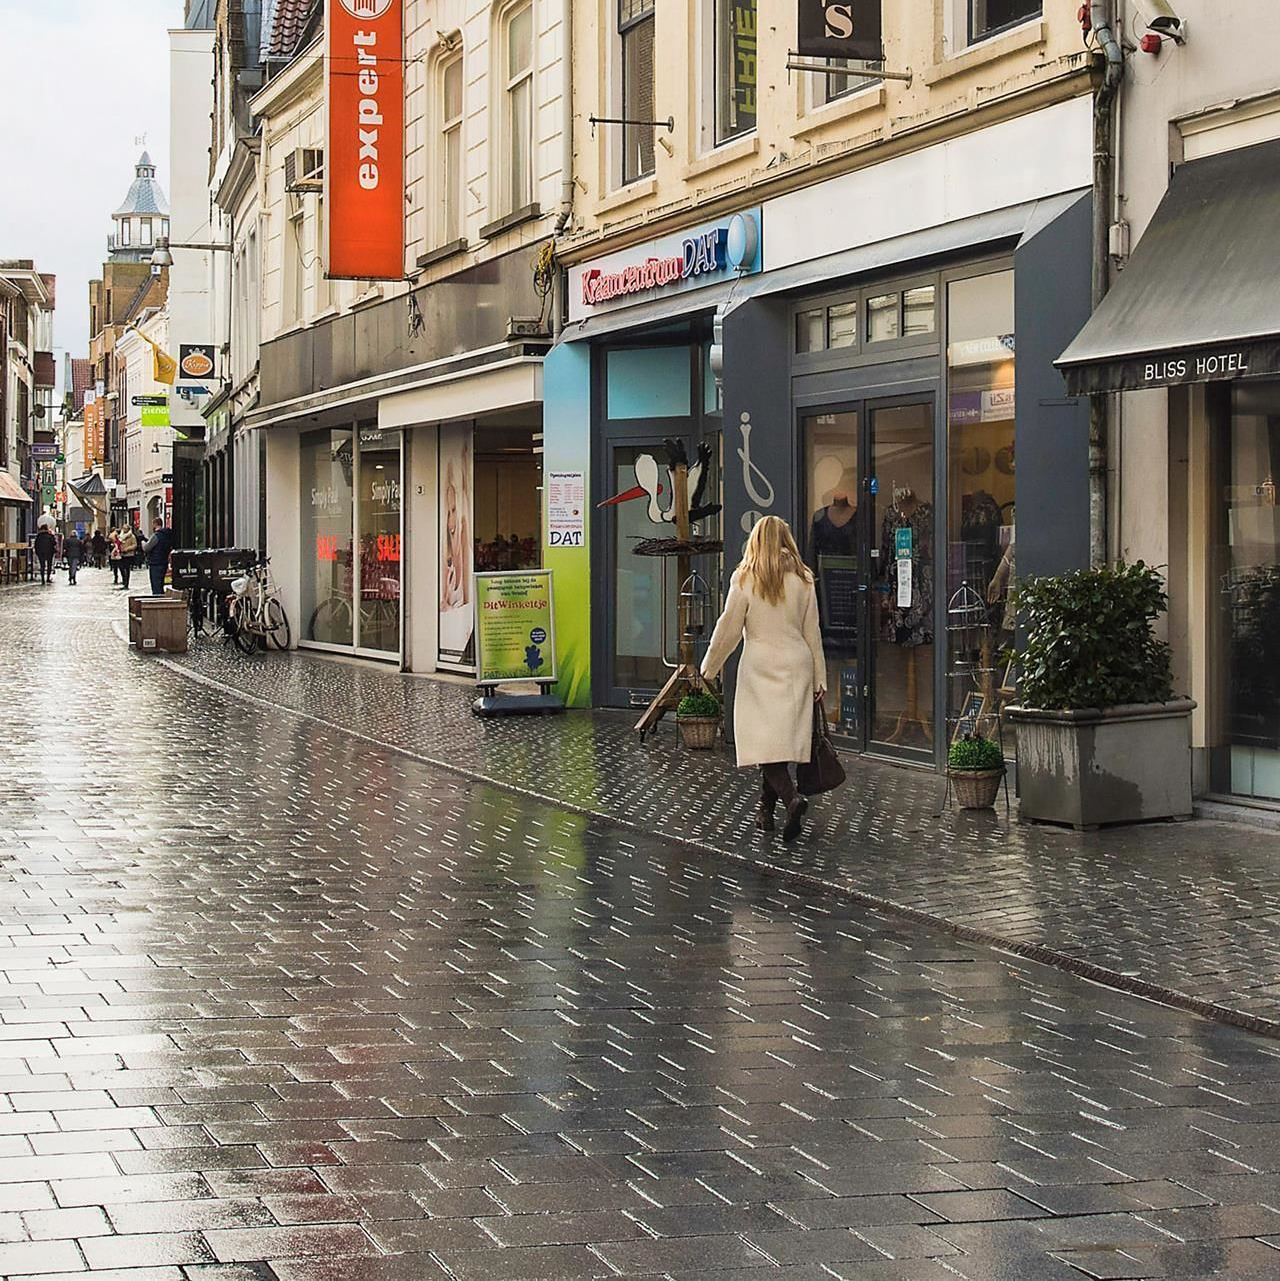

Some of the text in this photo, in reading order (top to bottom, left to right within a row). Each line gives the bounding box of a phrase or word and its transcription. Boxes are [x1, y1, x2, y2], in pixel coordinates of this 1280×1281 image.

[353, 29, 383, 191] expert
[580, 228, 721, 305] Kraamcentrum DAT
[1144, 353, 1248, 381] BLISS HOTEL
[417, 485, 423, 495] 3
[317, 535, 338, 560] SALE
[377, 534, 401, 561] SALE
[549, 531, 582, 545] DAT
